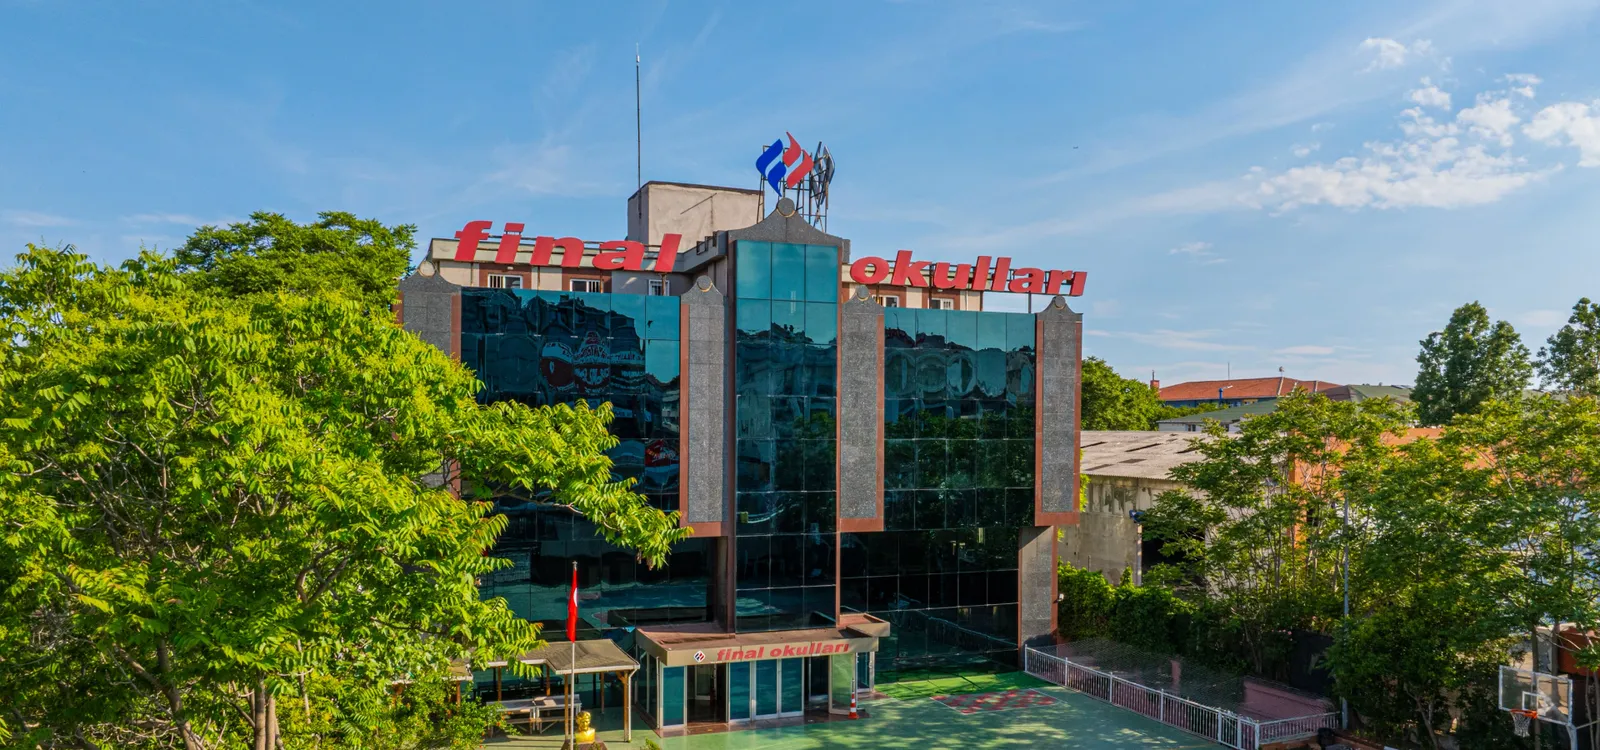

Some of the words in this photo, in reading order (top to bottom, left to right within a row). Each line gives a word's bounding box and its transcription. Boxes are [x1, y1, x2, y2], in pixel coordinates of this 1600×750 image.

[454, 220, 682, 272] final
[850, 250, 1087, 296] okulları
[717, 646, 764, 661] final
[769, 642, 849, 657] okulları
